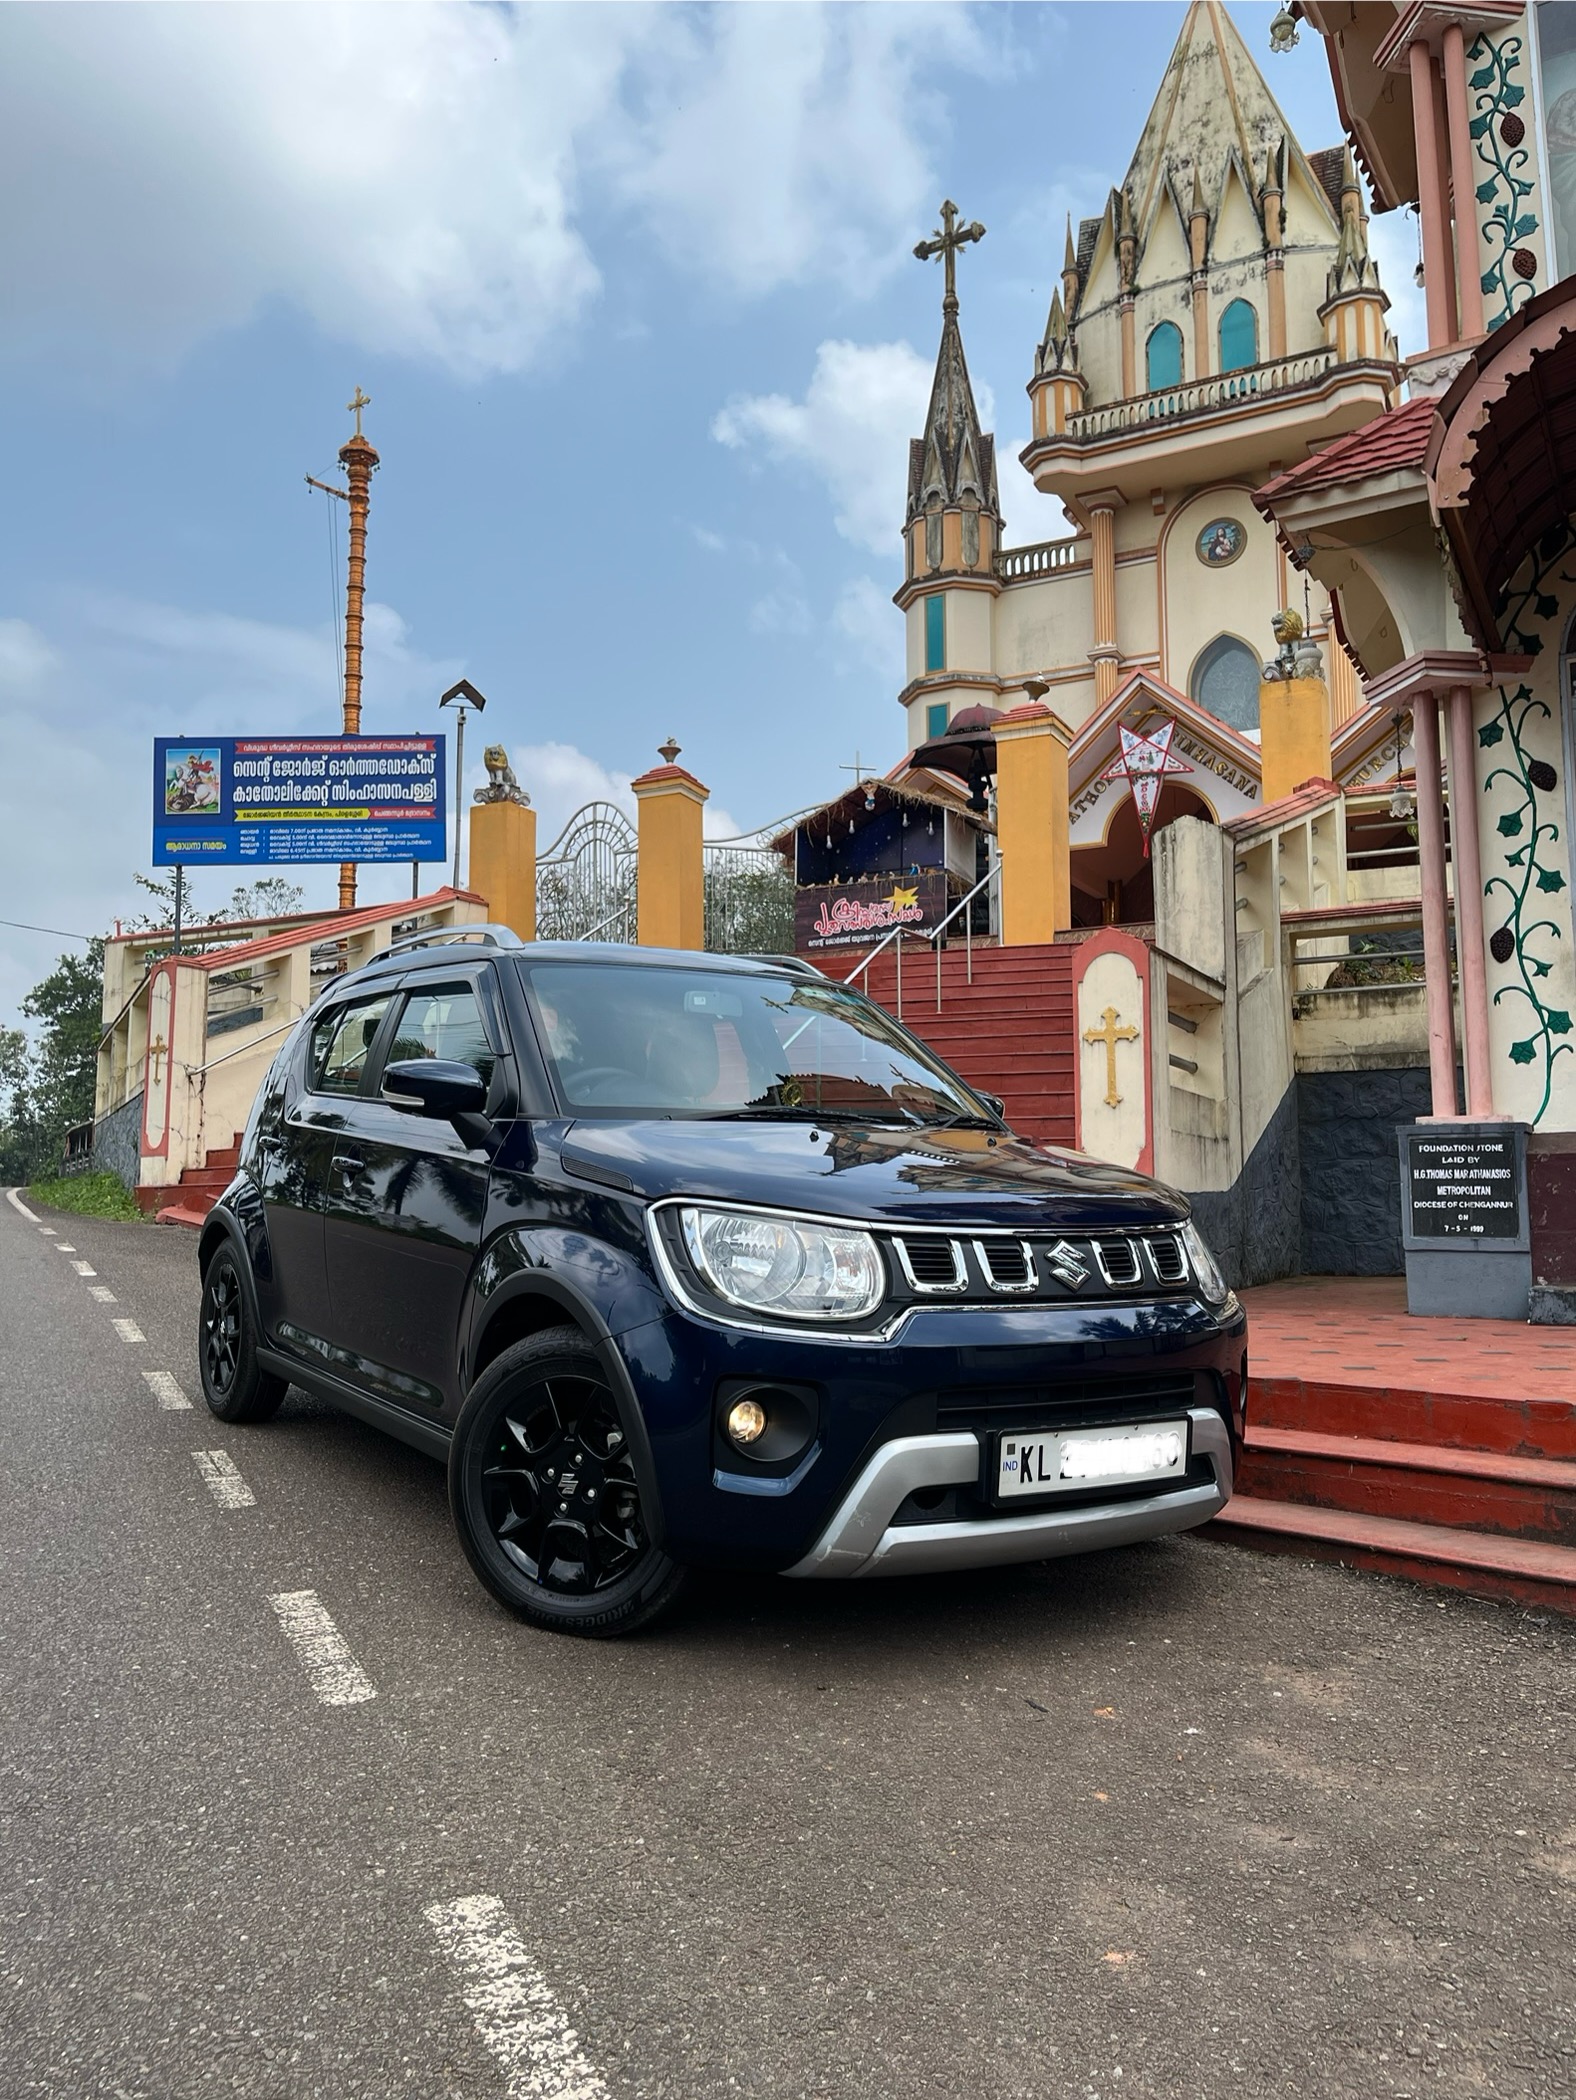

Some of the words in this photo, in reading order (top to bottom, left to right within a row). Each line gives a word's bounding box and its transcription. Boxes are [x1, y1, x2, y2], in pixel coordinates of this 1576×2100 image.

[233, 755, 272, 782] സെന്റ്
[272, 755, 328, 777] ജോർജ്
[329, 753, 437, 776] ഓർത്തഡോക്സ്
[1344, 738, 1409, 788] HURCH
[233, 779, 331, 806] കാതോലിക്കേറ്റ്
[332, 778, 437, 802] സിംഹാസനപള്ളി
[1418, 1144, 1474, 1153] FOUNDATION
[1475, 1143, 1504, 1152] STONE
[1441, 1156, 1465, 1164] LAID
[1453, 1169, 1468, 1179] MAR
[1469, 1168, 1511, 1179] ATHANASIOS
[1436, 1185, 1491, 1196] METROPOLITAN
[1458, 1201, 1514, 1209] CHENGANNUR
[1457, 1213, 1469, 1221] ON
[1002, 1460, 1018, 1472] IND
[1019, 1444, 1051, 1484] KL
